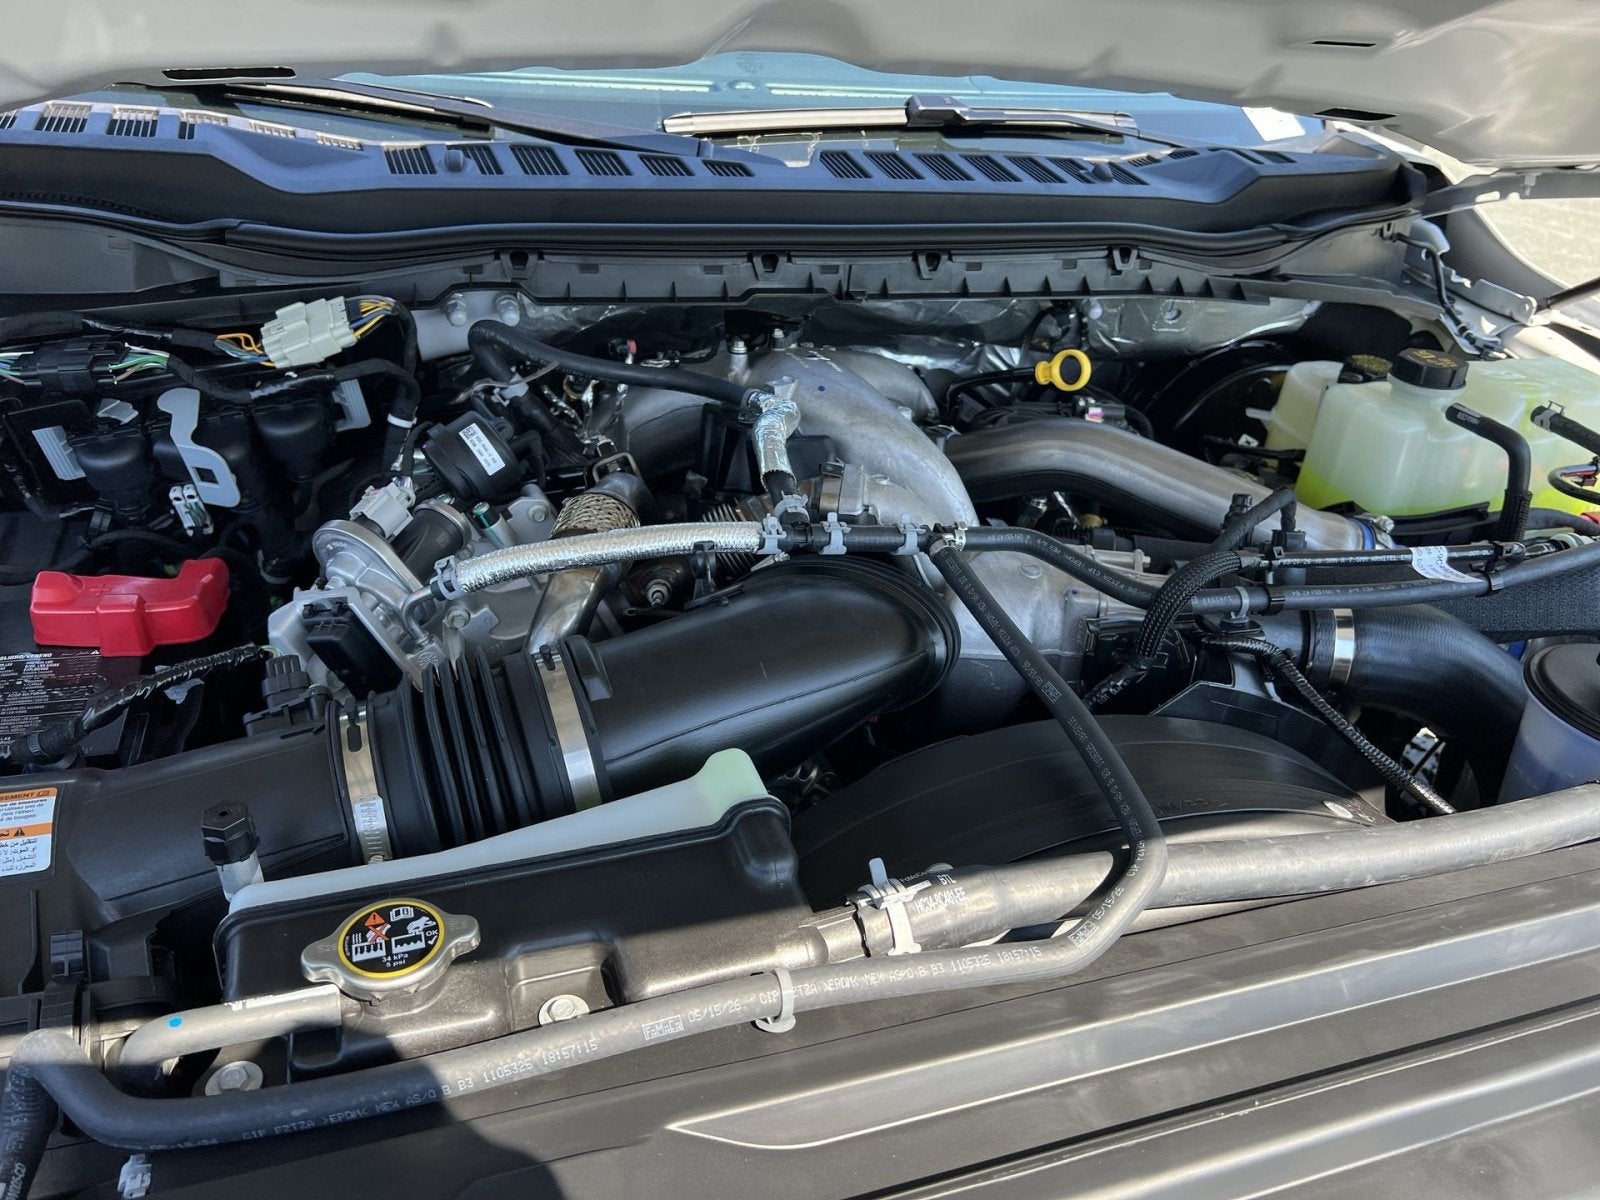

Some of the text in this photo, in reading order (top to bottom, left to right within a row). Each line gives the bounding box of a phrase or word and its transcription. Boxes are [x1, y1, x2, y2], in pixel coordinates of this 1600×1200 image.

[937, 874, 957, 886] BTL
[1092, 886, 1125, 920] 05/15/26
[425, 929, 439, 937] OK
[393, 953, 409, 961] kPa
[688, 1000, 742, 1024] 05/15/26
[950, 953, 992, 975] 1105325
[273, 1118, 316, 1136] FZTZA
[375, 1099, 401, 1112] MEX
[457, 1076, 475, 1091] B3
[482, 1057, 534, 1084] 1105325
[541, 1037, 599, 1066] 18:57:15
